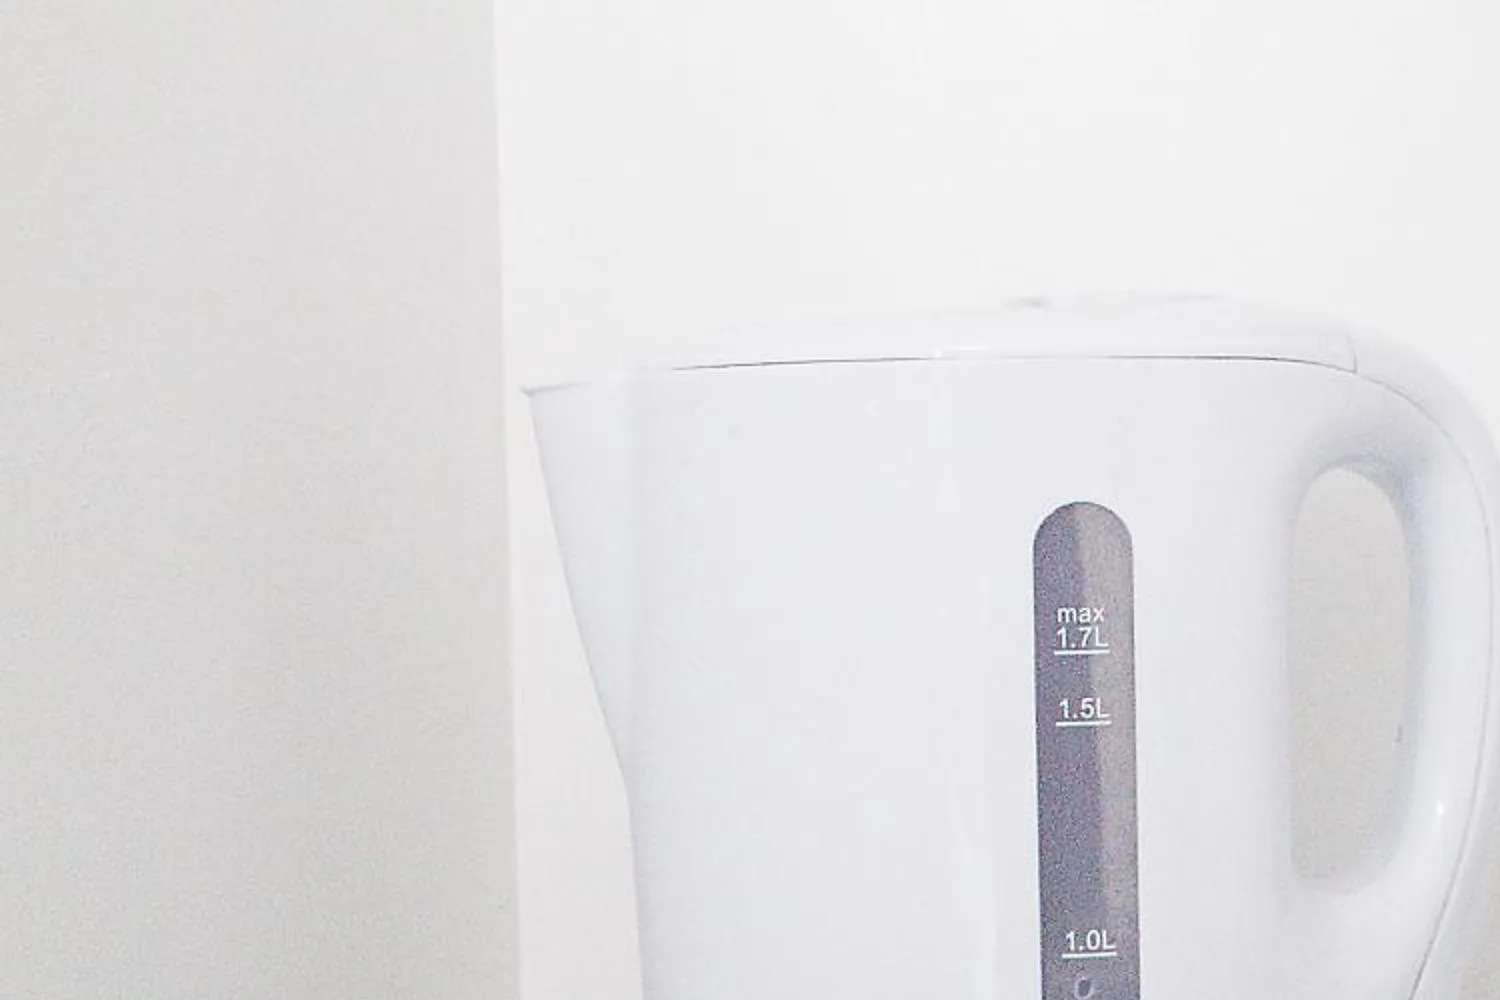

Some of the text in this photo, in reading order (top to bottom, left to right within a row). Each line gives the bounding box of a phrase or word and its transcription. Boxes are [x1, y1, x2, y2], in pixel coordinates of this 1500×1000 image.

[1056, 606, 1105, 623] max
[1056, 626, 1109, 648] 1.7L
[1059, 697, 1111, 719] 1.5L
[1065, 929, 1116, 951] 1.0L
